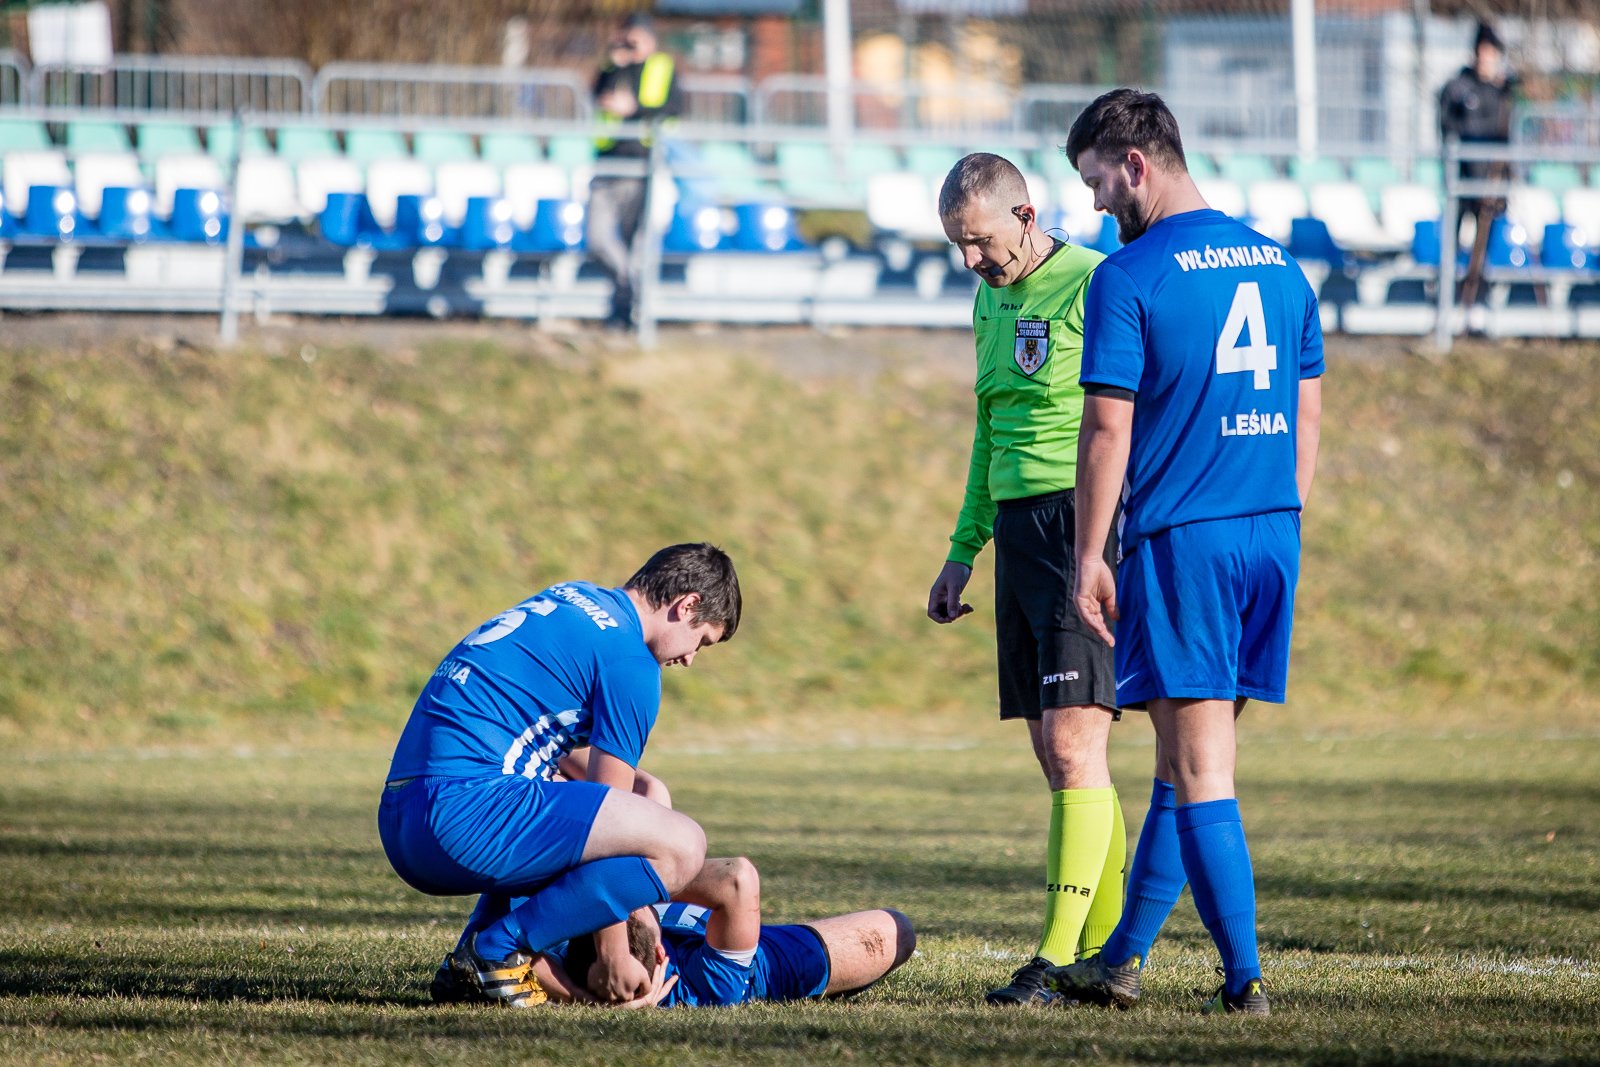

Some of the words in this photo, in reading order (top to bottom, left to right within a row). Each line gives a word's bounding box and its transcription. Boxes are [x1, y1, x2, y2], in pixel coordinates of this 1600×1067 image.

[1173, 244, 1287, 272] WŁÓKNIARZ
[1216, 281, 1277, 390] 4
[1221, 408, 1288, 437] LEŚNA
[549, 583, 619, 631] ŁÓKNIARZ
[1043, 671, 1079, 685] zina
[1047, 883, 1090, 898] zina
